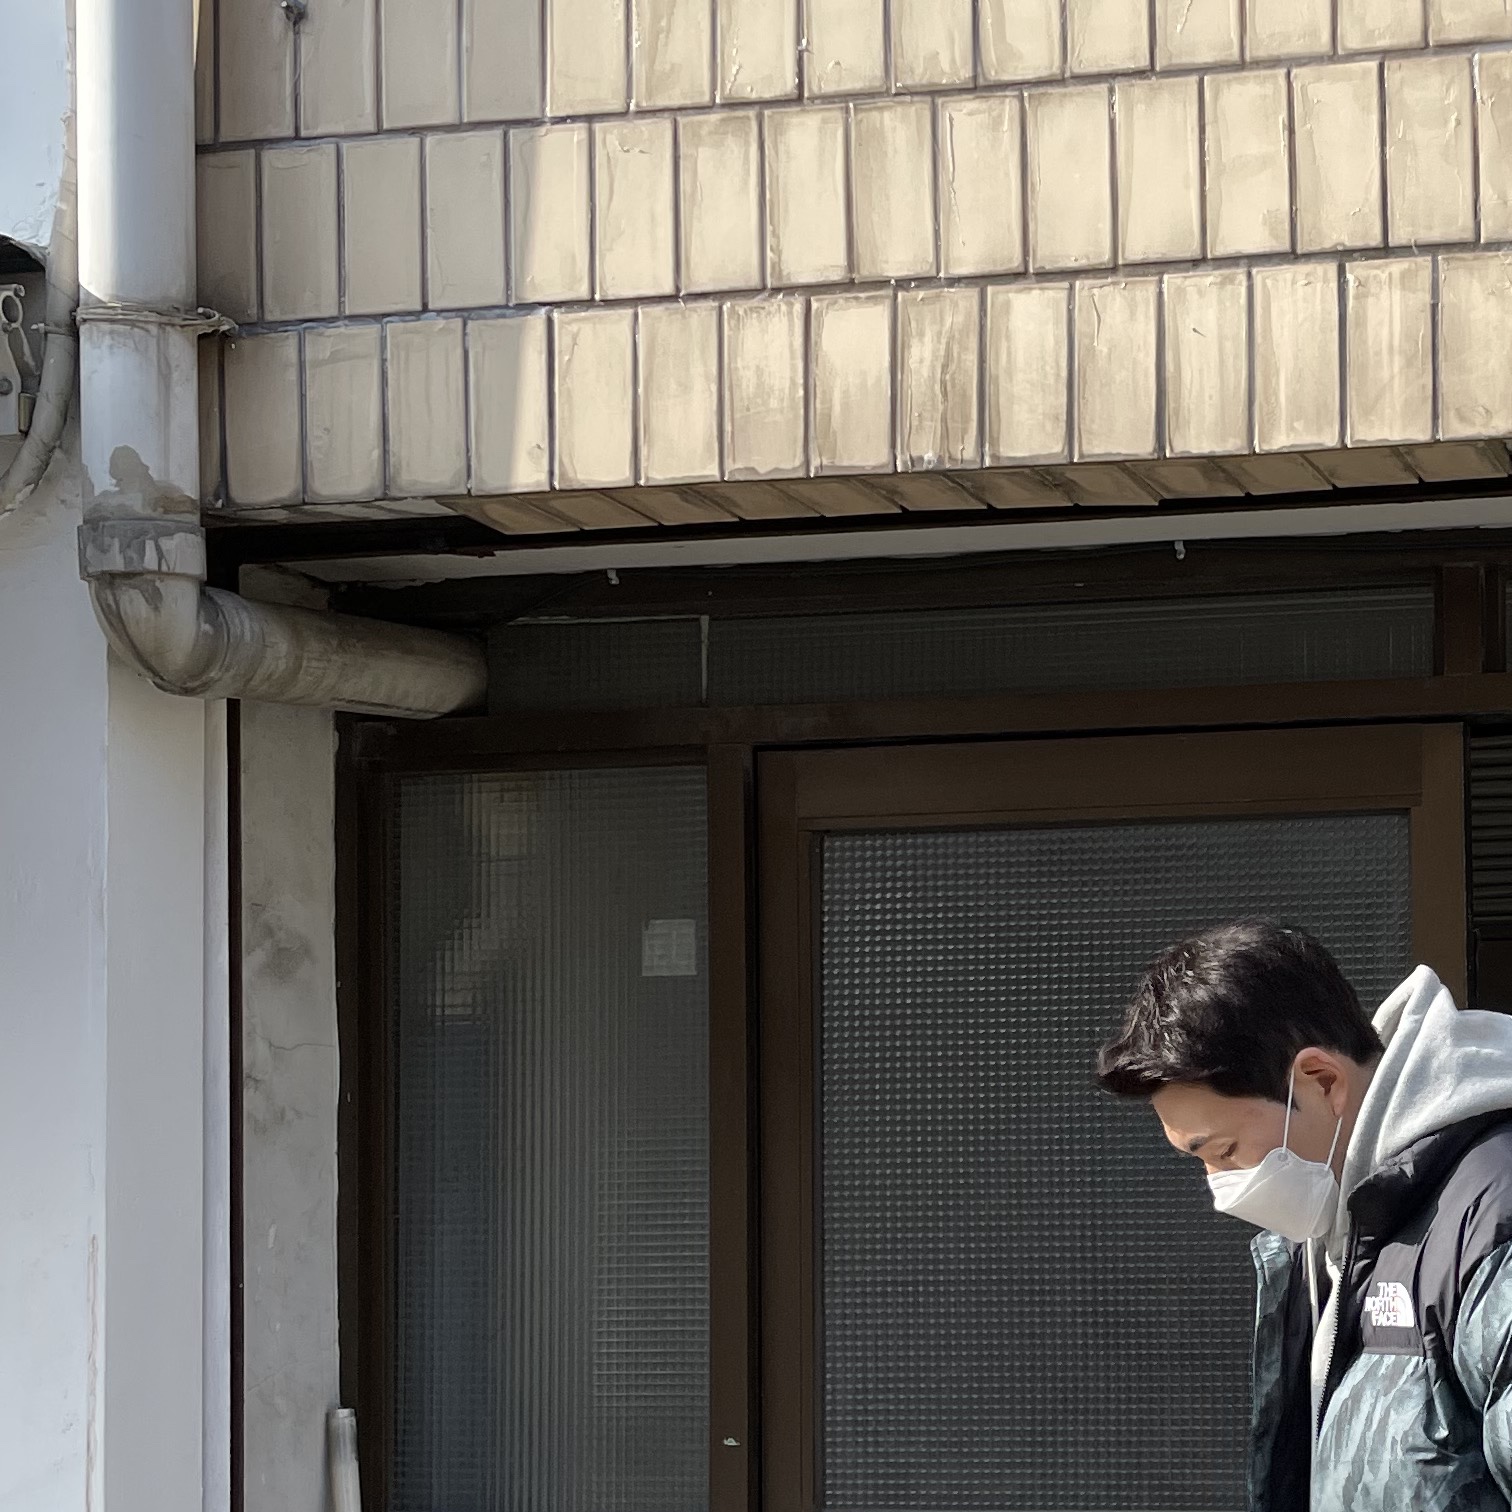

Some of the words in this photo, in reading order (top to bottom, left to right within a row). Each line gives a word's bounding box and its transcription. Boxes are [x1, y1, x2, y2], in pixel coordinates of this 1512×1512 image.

[1377, 1282, 1398, 1297] THE
[1364, 1296, 1398, 1312] NORTH
[1371, 1312, 1398, 1327] FACE
